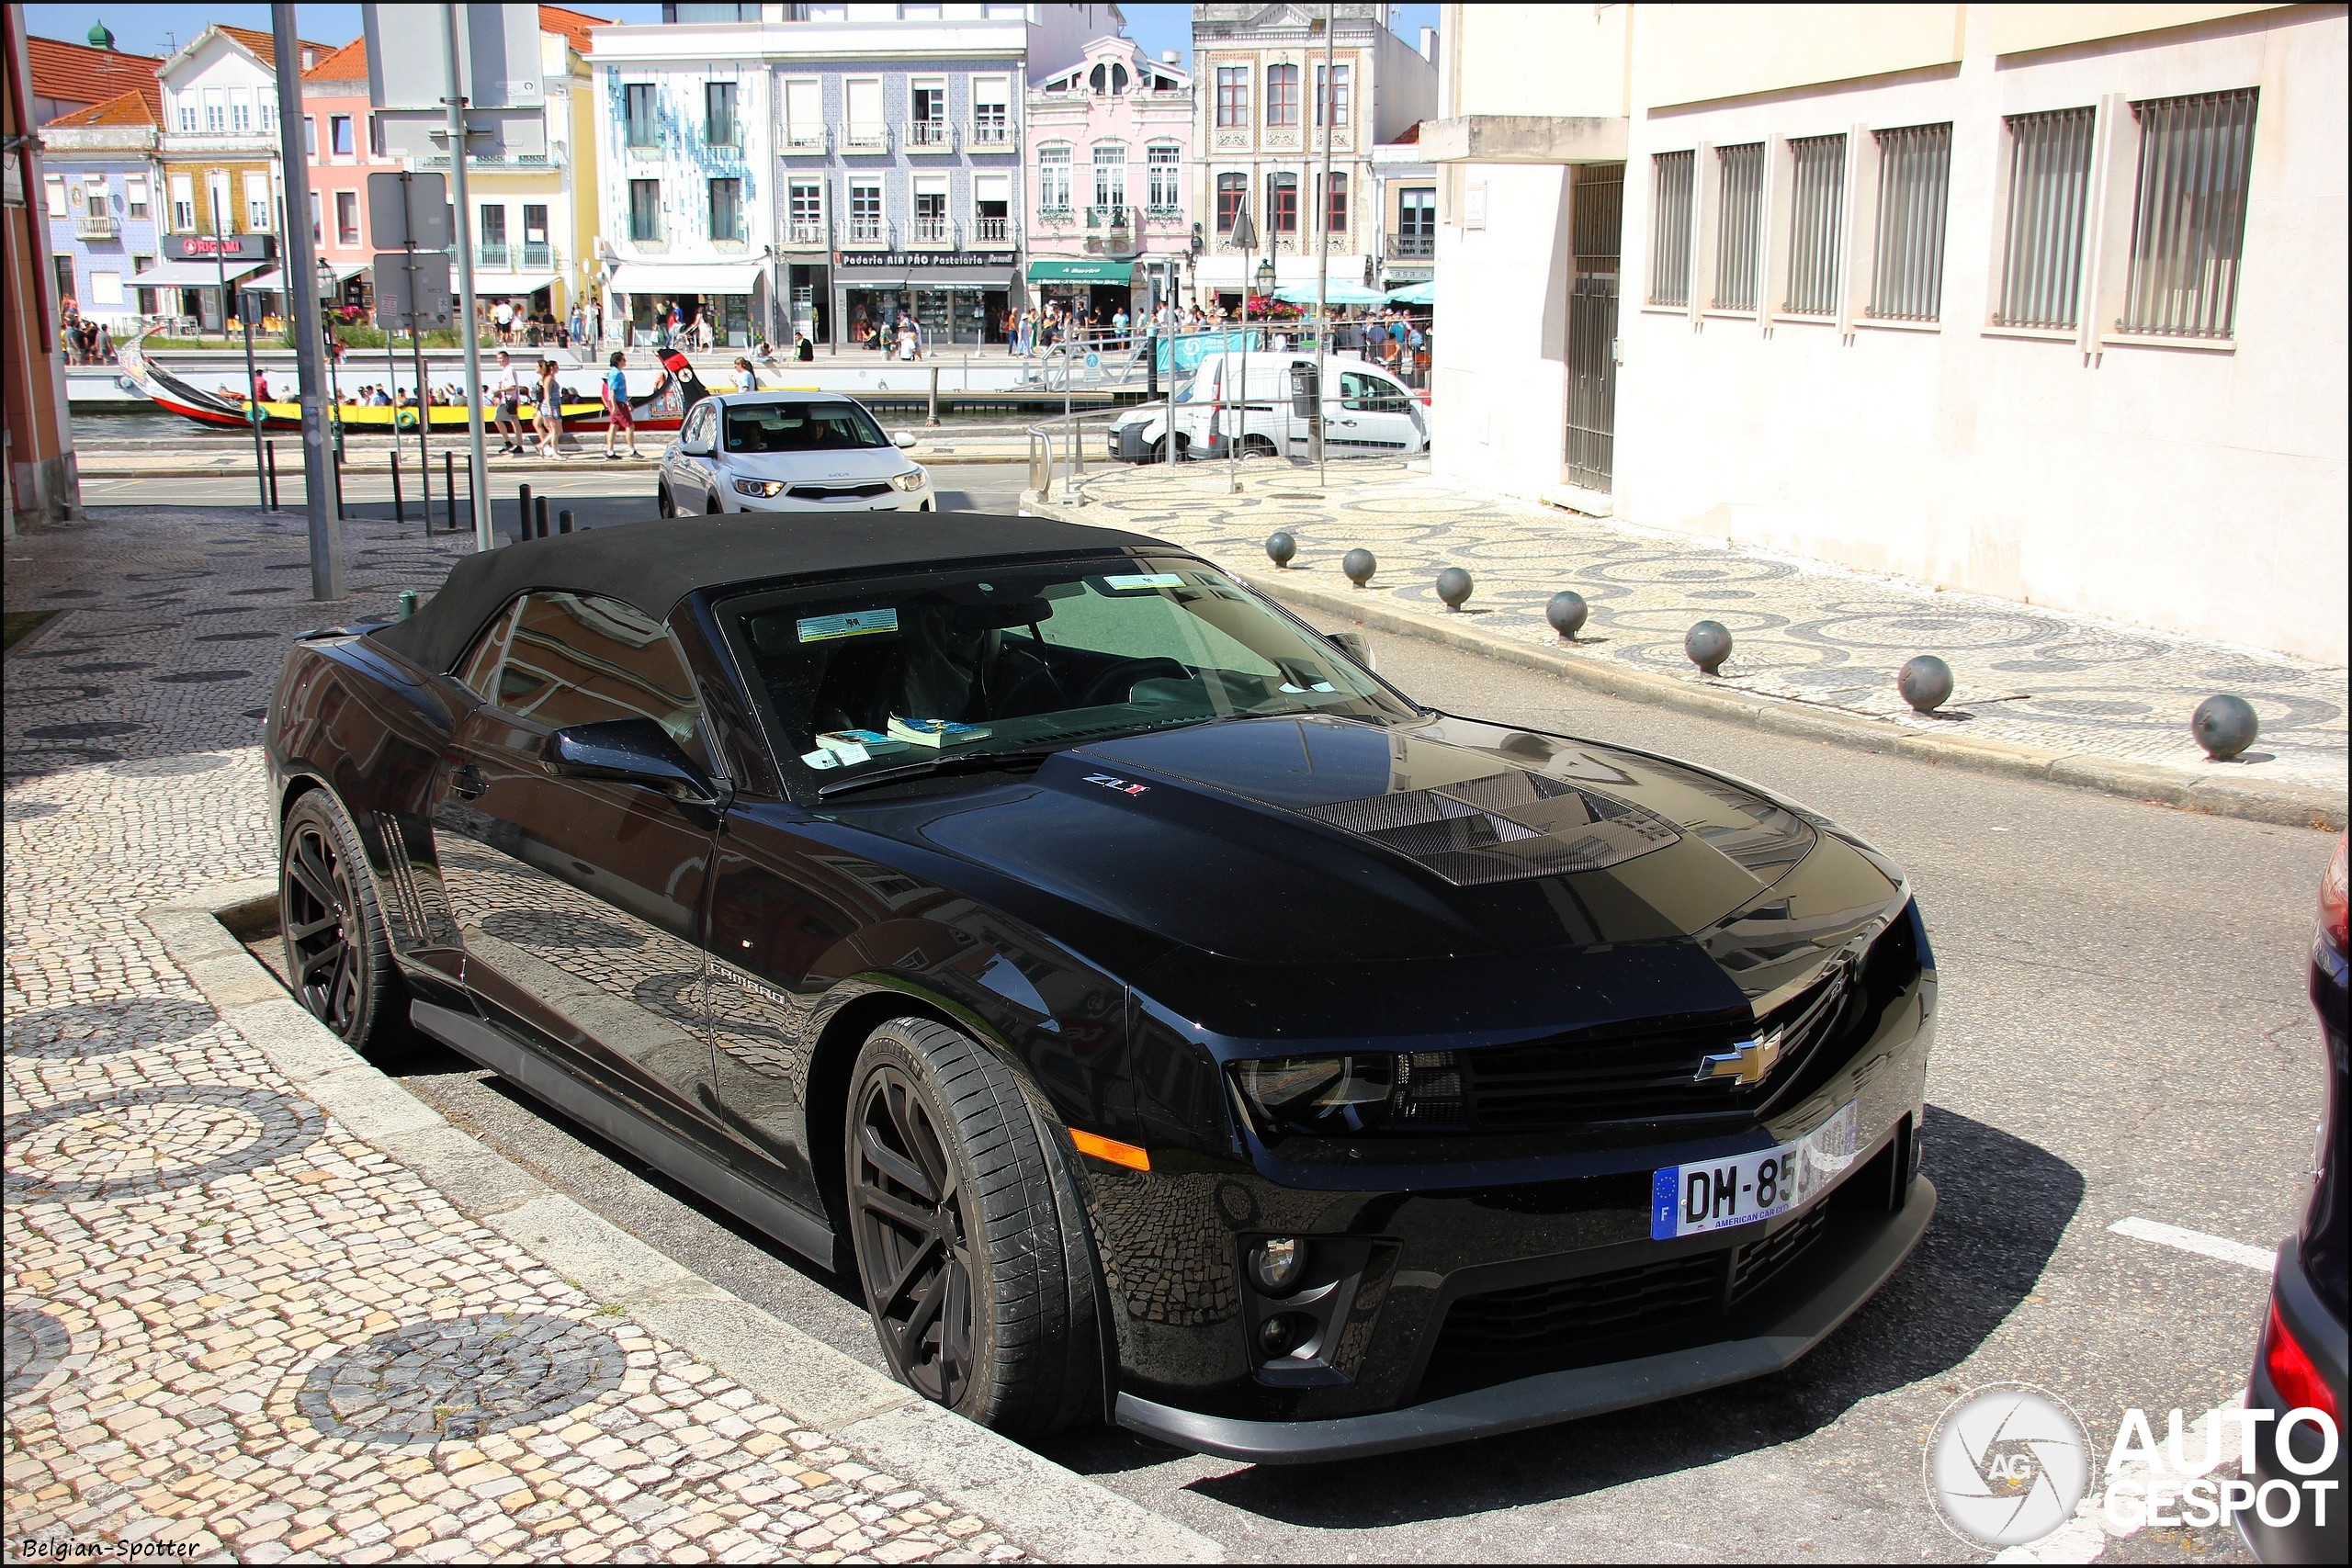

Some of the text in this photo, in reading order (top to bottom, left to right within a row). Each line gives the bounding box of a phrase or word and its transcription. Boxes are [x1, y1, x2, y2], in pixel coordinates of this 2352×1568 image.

[843, 254, 983, 265] Padaria RIA PÃO Pastelaria
[1660, 1206, 1669, 1222] F
[1715, 1213, 1758, 1229] AMERICAN
[1759, 1207, 1774, 1219] CAR
